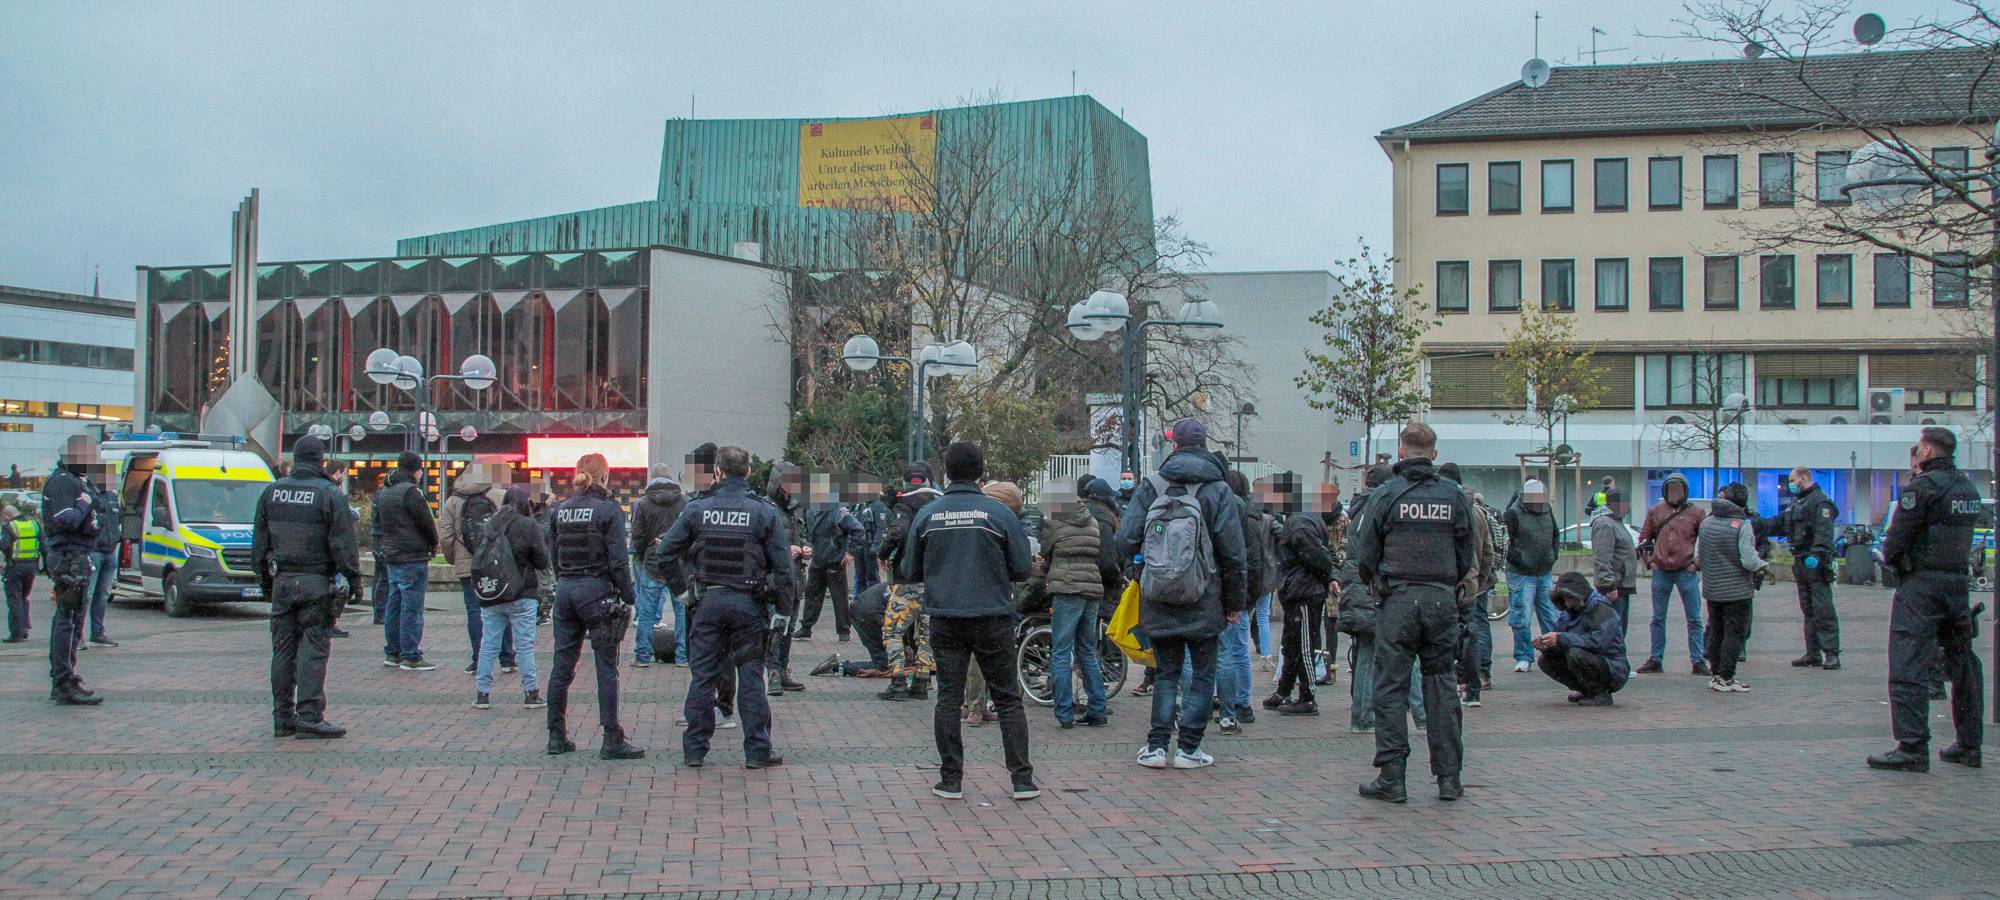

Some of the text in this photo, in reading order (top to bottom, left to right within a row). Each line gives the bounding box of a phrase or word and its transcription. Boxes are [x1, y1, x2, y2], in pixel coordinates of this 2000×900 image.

[821, 145, 871, 159] Kulturelle
[818, 160, 914, 174] Unter diesem Dac
[807, 180, 850, 191] arbeiten
[853, 177, 905, 188] Menschen
[272, 489, 315, 504] POLIZEI
[1400, 503, 1452, 520] POLIZEI
[1951, 499, 1980, 514] POLIZE
[557, 508, 594, 523] POLIZEI
[703, 510, 751, 527] POLIZEI
[931, 509, 989, 521] AUSLÄNDERBEHÖRDE
